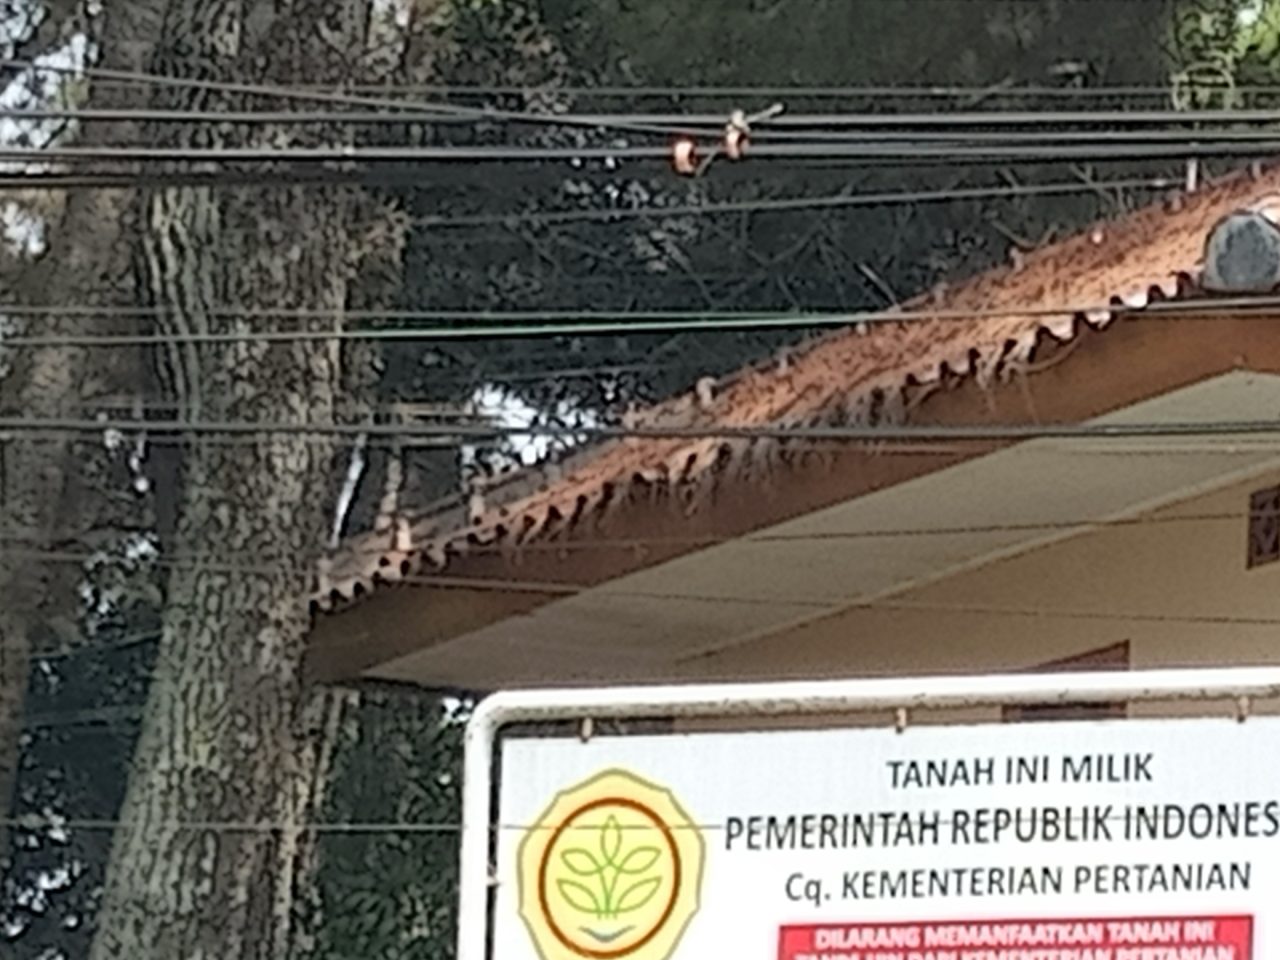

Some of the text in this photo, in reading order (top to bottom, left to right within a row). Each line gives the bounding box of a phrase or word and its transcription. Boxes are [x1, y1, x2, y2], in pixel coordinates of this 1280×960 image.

[886, 752, 1153, 789] TANAH INI MILIK
[725, 810, 940, 851] PEMERINTAH
[951, 804, 1114, 846] REPUBLIK
[785, 861, 1252, 908] Cq. KEMENTERIAN PERTANIAN
[815, 919, 1216, 950] DILARANG MEMANFAATKAN TANAH INI
